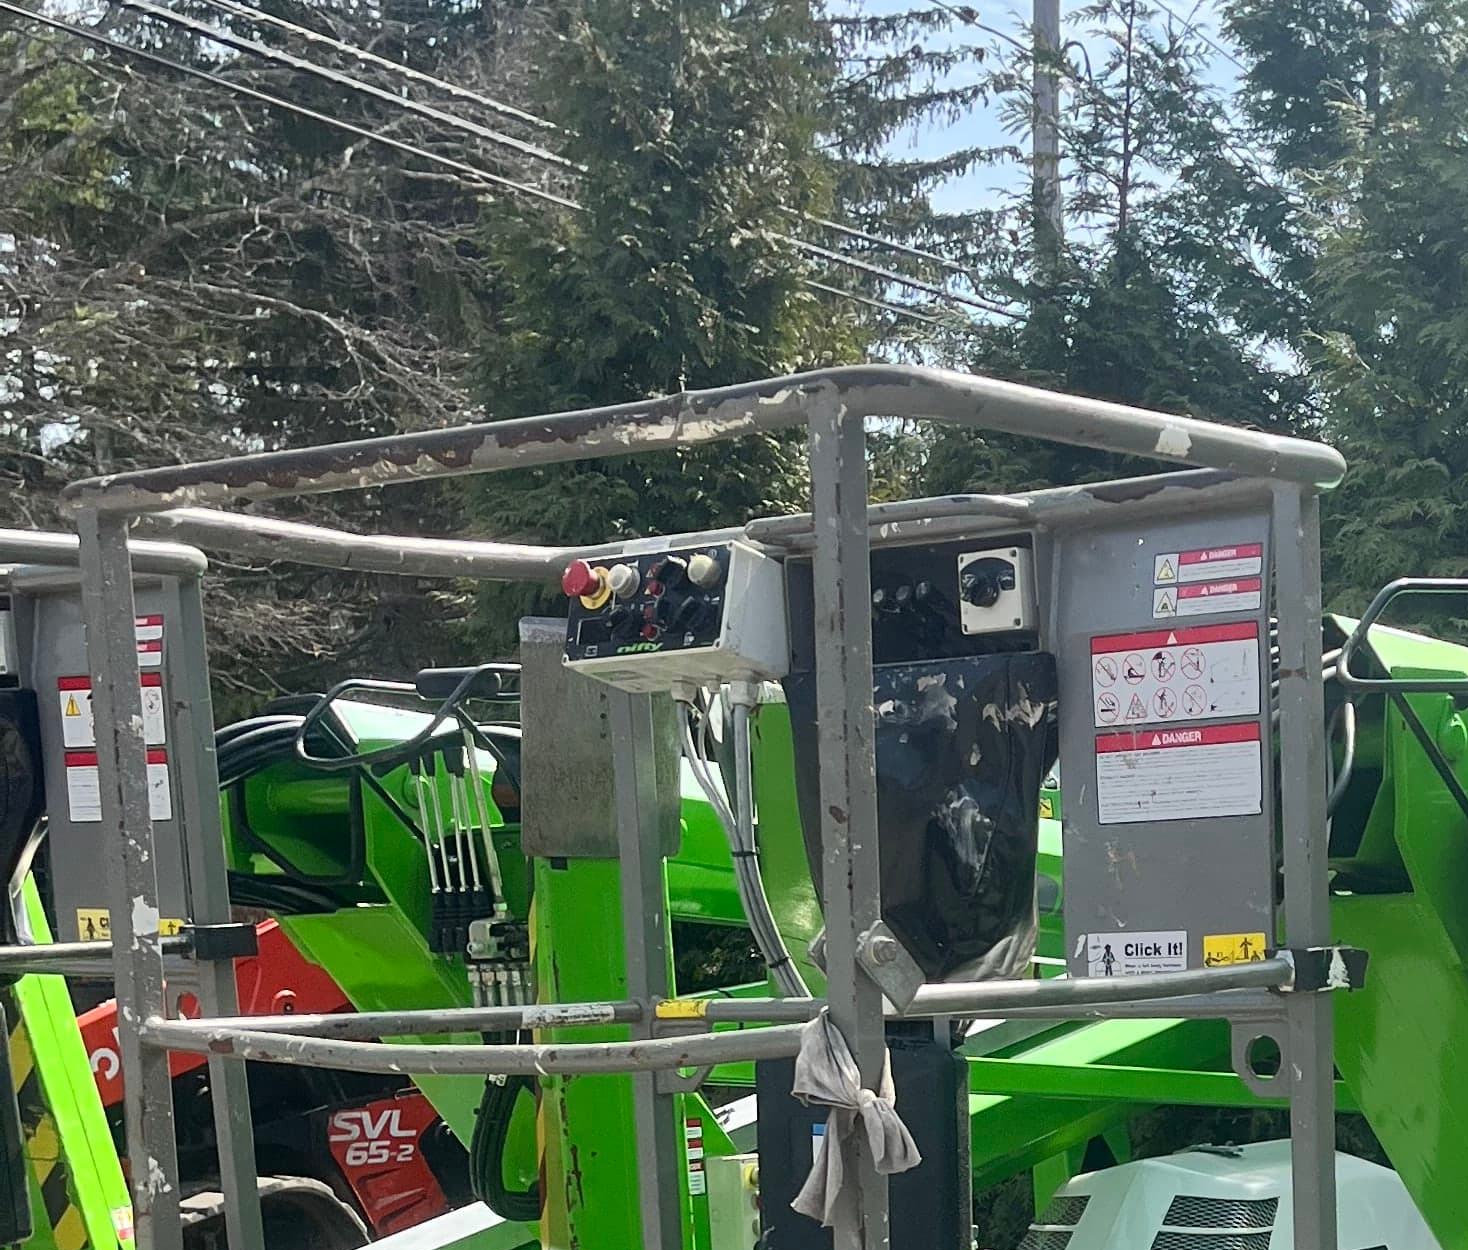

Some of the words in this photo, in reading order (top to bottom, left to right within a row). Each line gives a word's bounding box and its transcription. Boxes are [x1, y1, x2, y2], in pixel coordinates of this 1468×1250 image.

[1208, 548, 1237, 560] DANGER
[1209, 583, 1238, 594] DANGER
[617, 642, 664, 654] nifty
[1161, 730, 1202, 745] DANGER
[1124, 942, 1164, 957] Click
[1167, 942, 1183, 956] It!
[329, 1109, 417, 1142] SVL
[345, 1140, 415, 1167] 65-2
